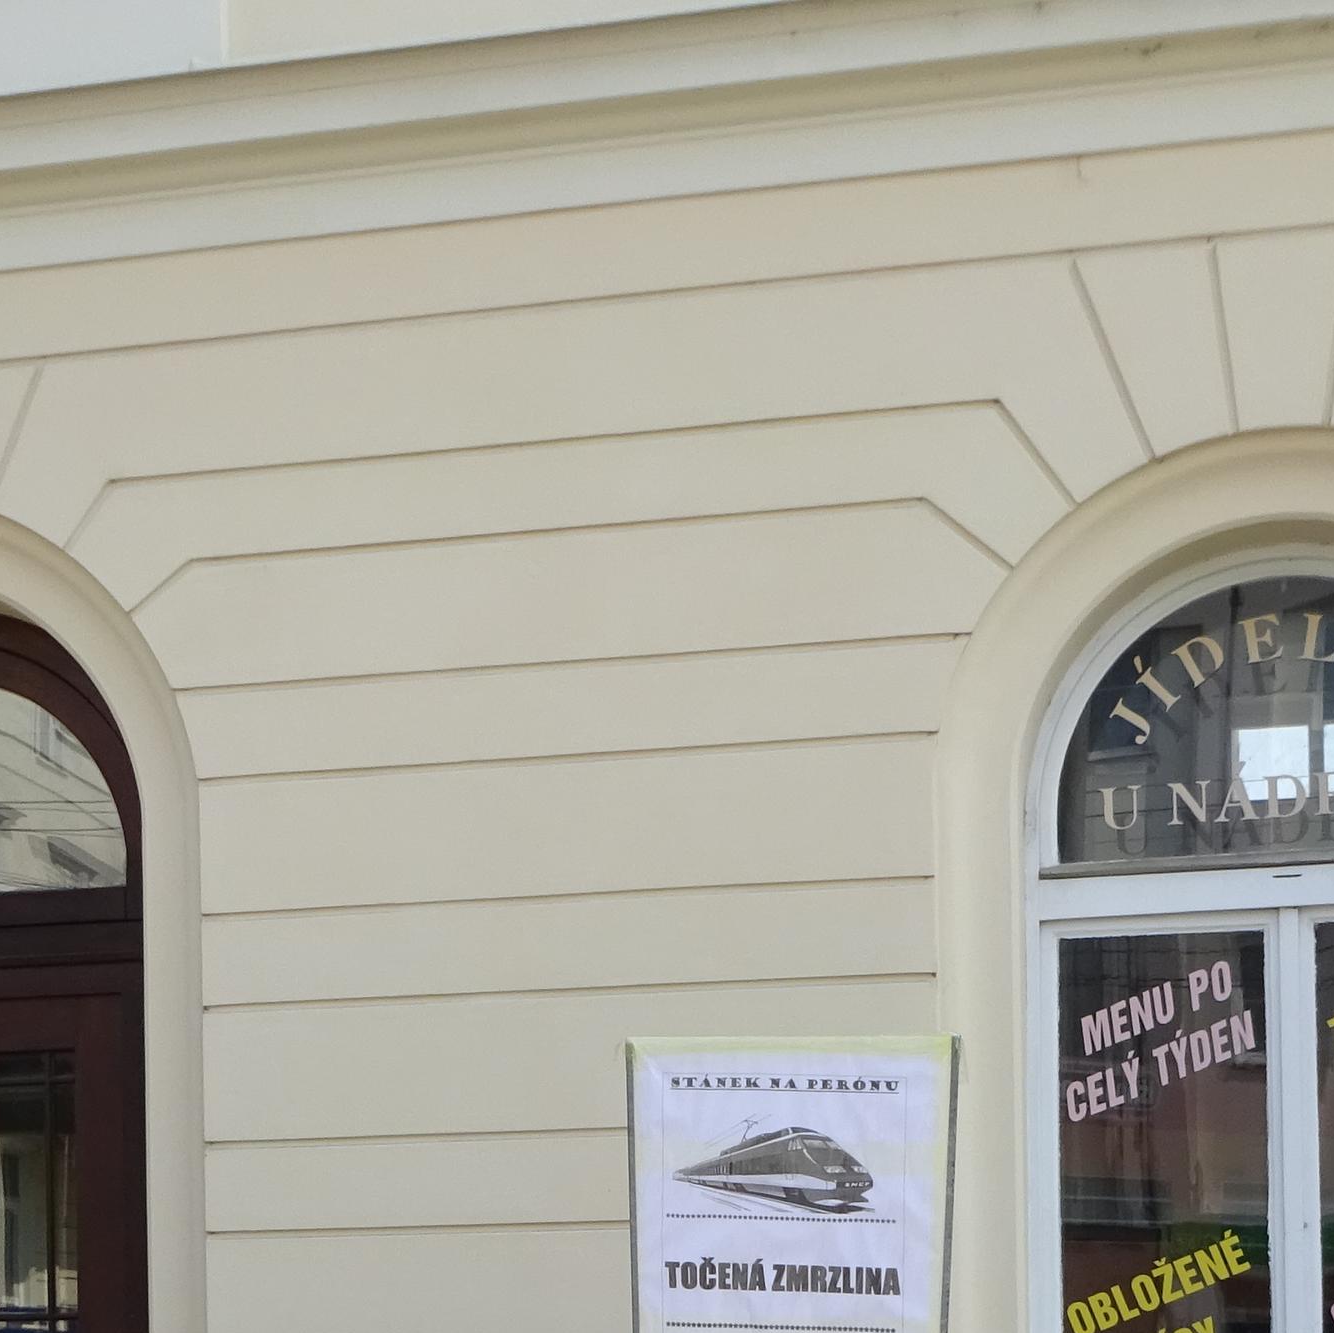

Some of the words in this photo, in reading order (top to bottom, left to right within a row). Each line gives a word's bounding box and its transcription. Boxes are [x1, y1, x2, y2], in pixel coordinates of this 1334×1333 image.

[1098, 785, 1141, 830] U
[1081, 981, 1174, 1056] MENU
[1188, 961, 1232, 1012] PO
[671, 1074, 760, 1089] STÁNEK
[769, 1078, 797, 1089] NA
[807, 1076, 899, 1091] PERÓNU
[1067, 1050, 1139, 1122] CELÝ
[1152, 1008, 1256, 1087] TÝDEN
[665, 1257, 766, 1292] TOČENÁ
[772, 1264, 901, 1295] ZMRZLINA
